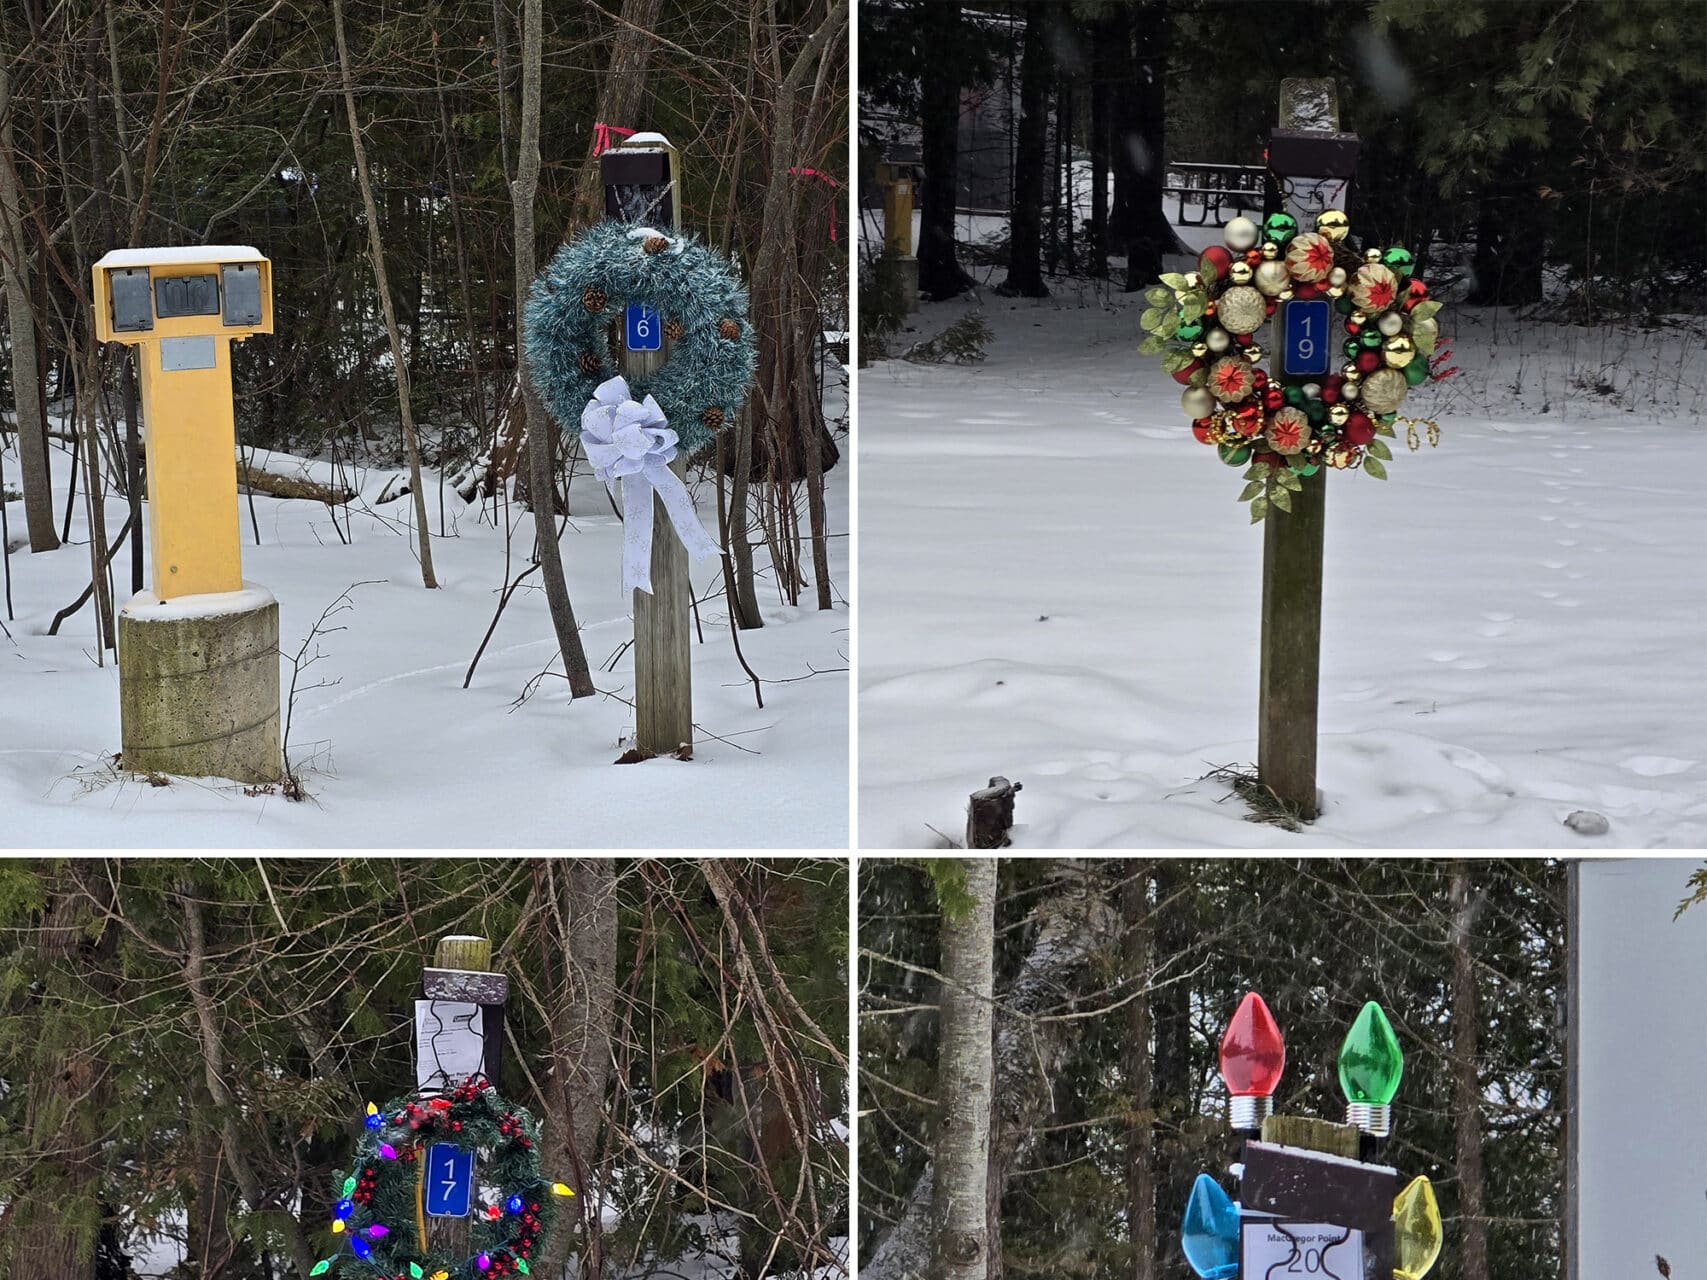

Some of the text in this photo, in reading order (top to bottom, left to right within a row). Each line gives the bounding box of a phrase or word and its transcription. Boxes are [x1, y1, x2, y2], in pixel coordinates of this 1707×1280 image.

[1298, 316, 1314, 360] 19
[441, 1158, 457, 1201] 17
[1267, 1234, 1341, 1244] MacGegor Point
[1287, 1248, 1321, 1273] 20
